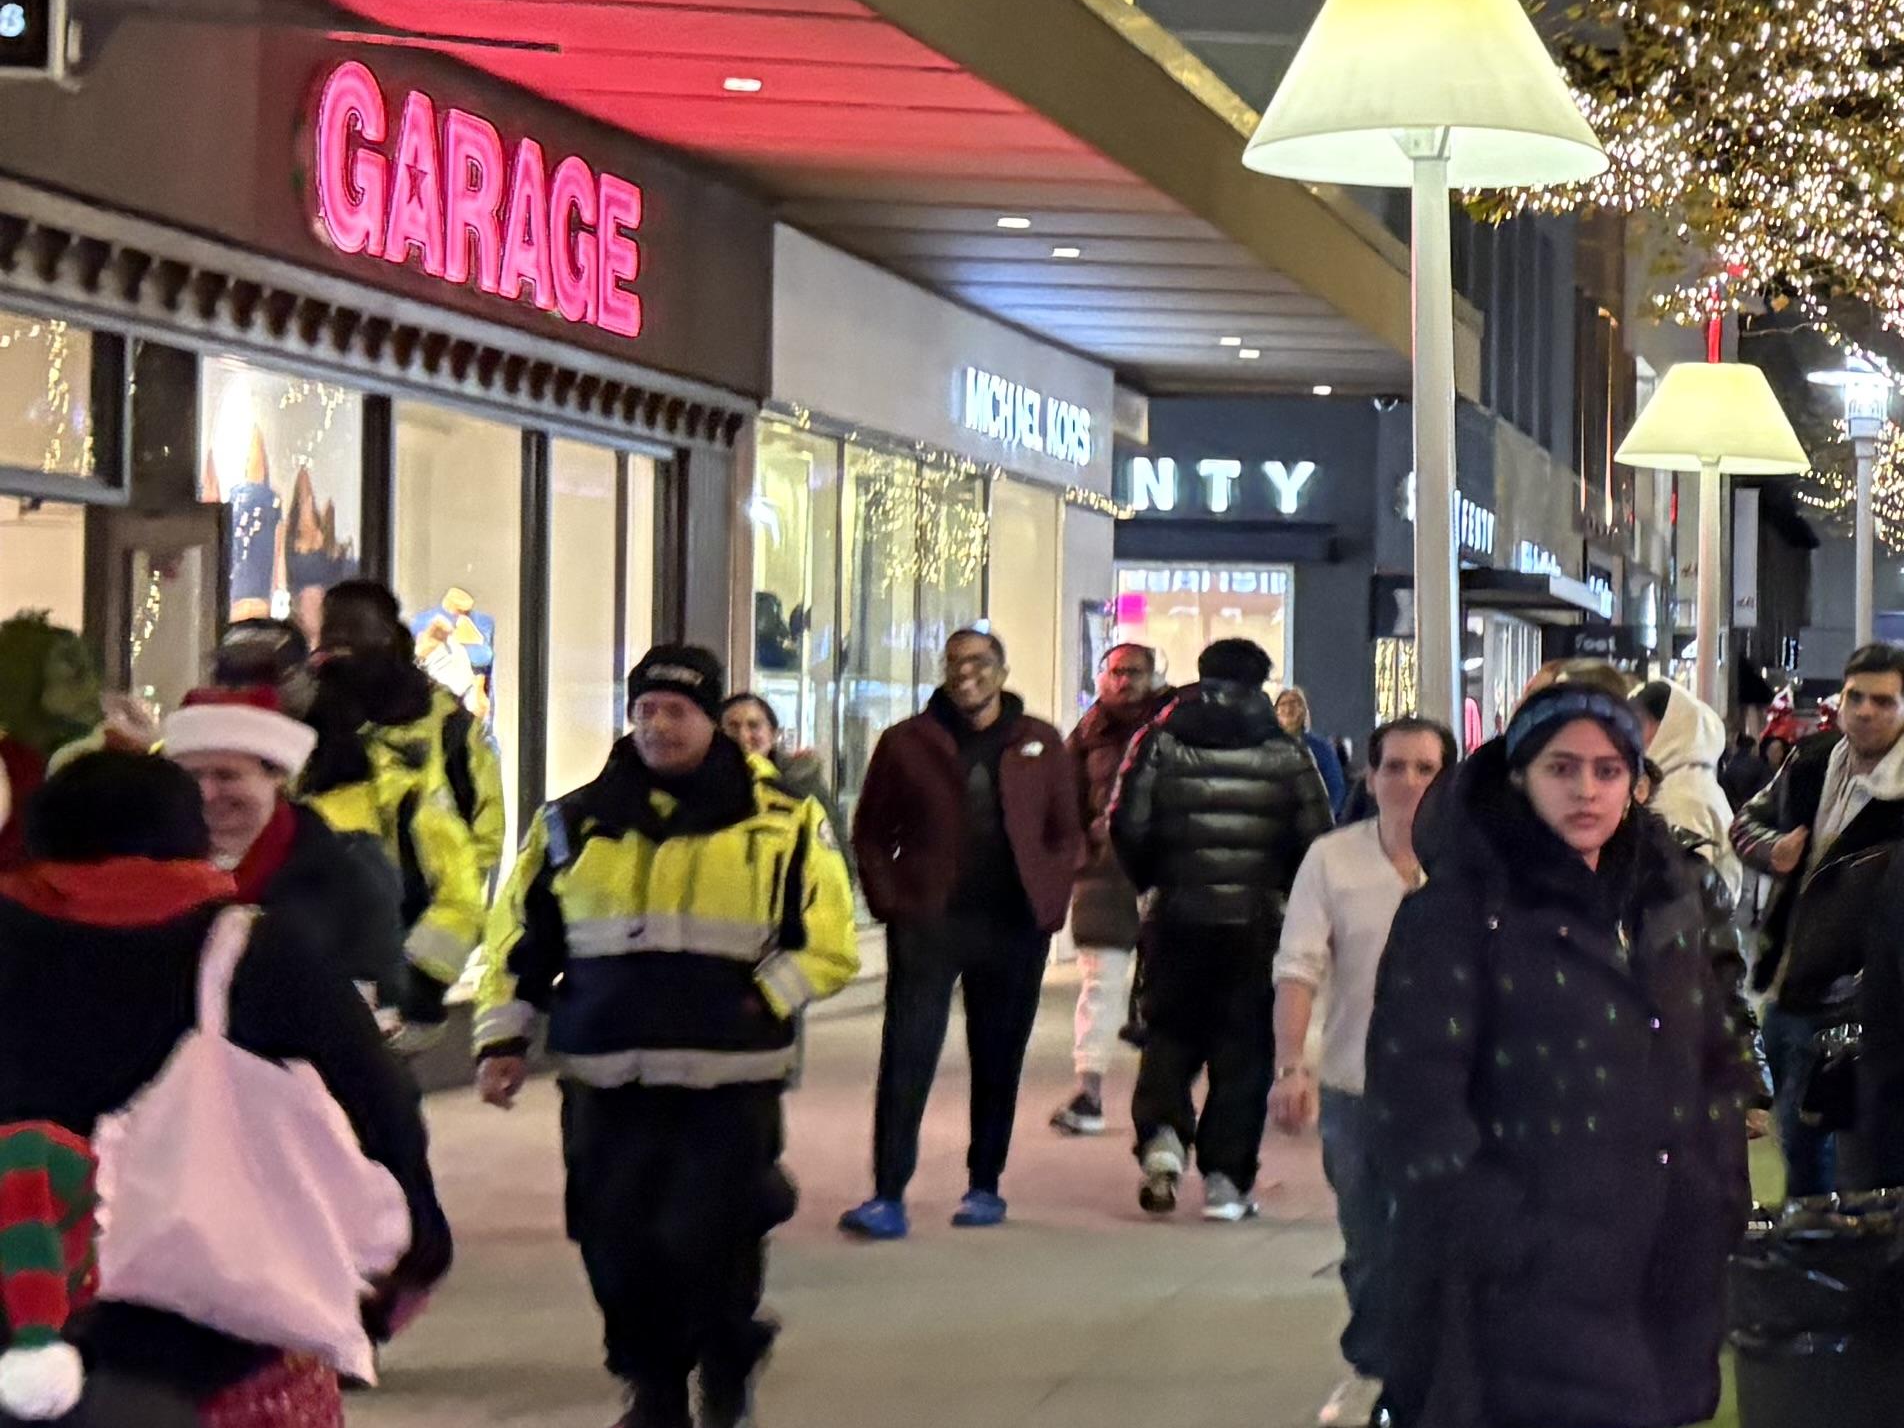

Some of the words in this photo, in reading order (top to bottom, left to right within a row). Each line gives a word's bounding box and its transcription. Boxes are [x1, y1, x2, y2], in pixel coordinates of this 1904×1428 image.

[316, 60, 643, 338] GARAGE
[965, 366, 1044, 453] MICHAEL
[1047, 397, 1091, 467] KORS
